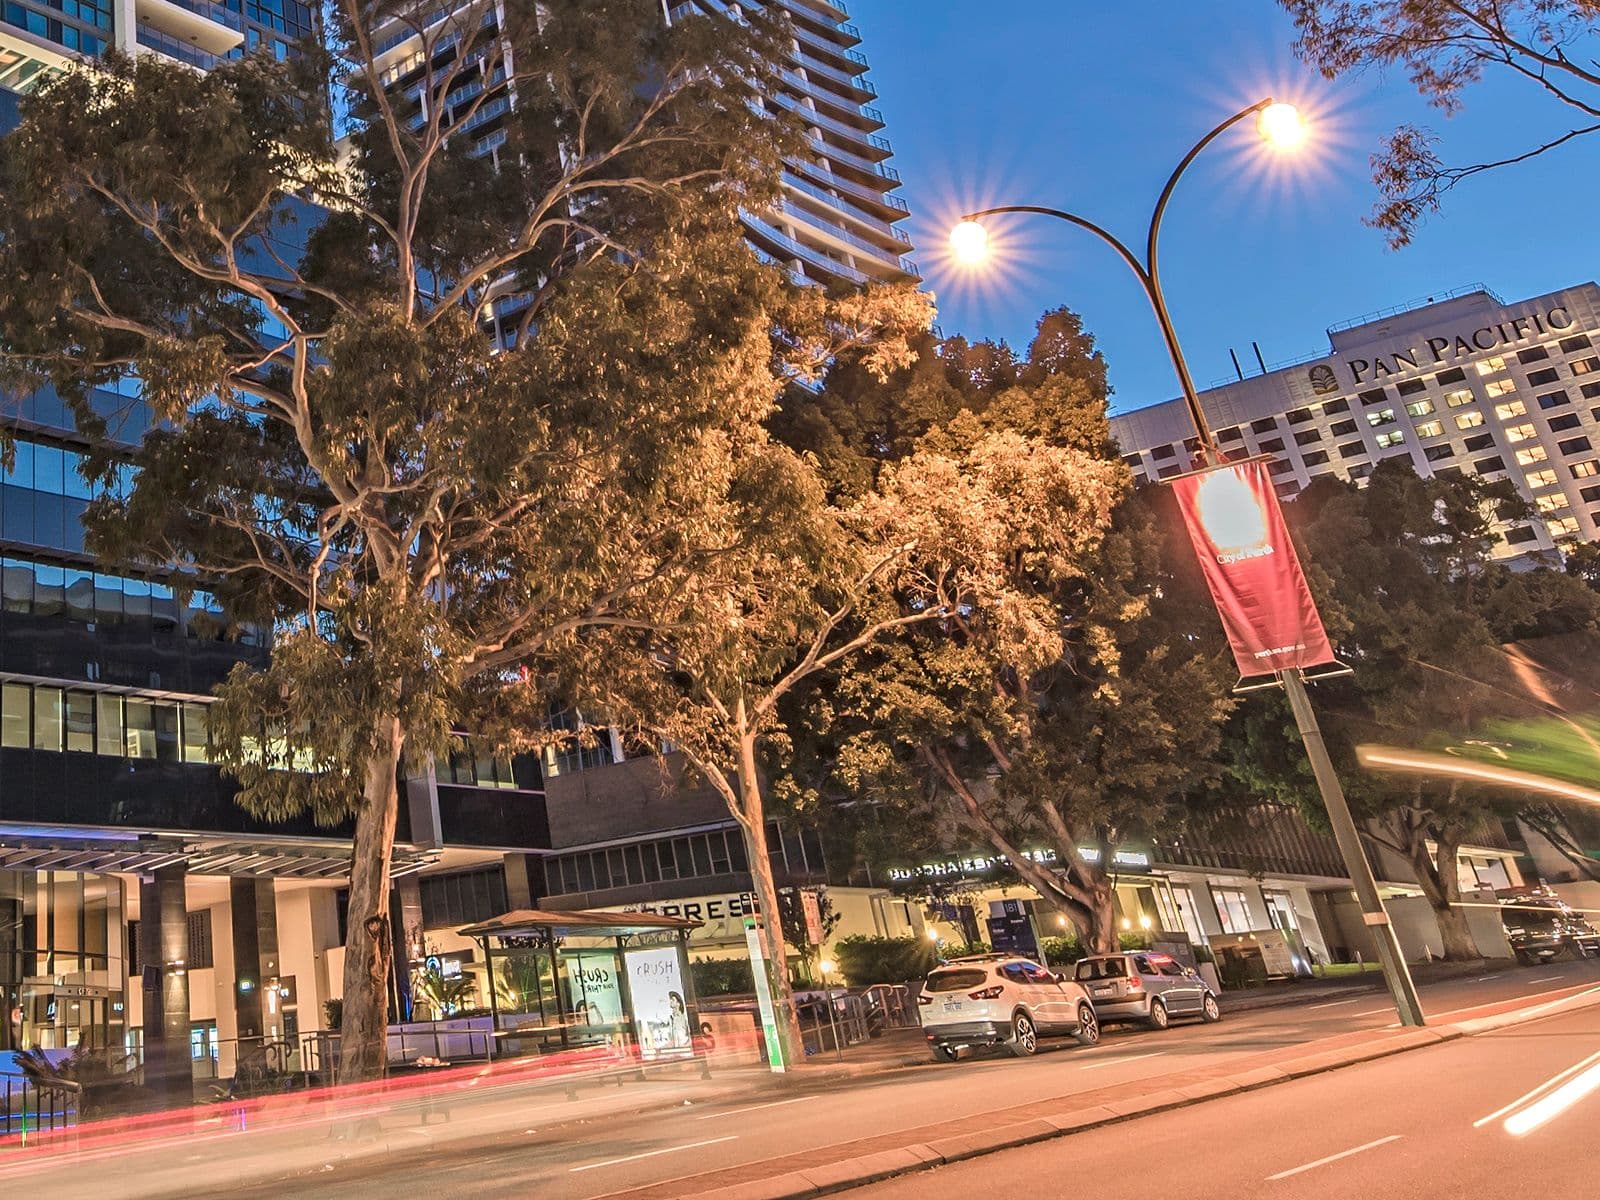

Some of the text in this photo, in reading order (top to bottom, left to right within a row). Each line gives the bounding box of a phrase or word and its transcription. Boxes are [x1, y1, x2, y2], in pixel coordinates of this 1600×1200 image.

[1348, 307, 1574, 384] PAN PACIFIC
[1004, 903, 1018, 913] 181
